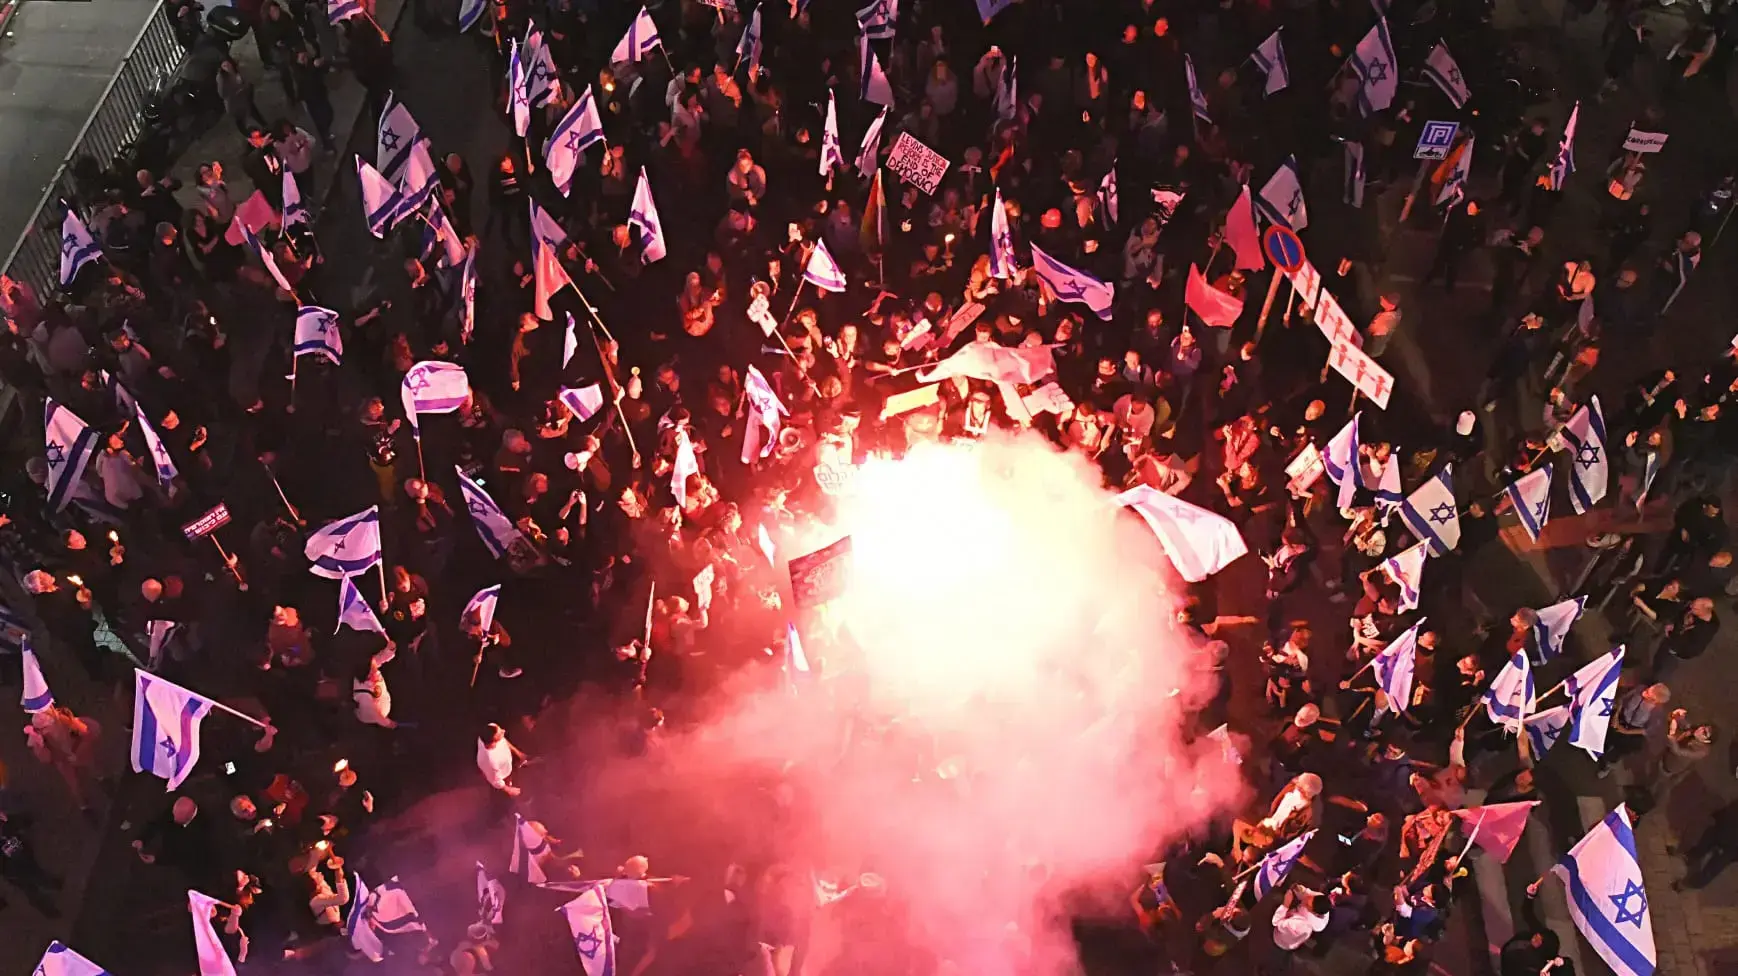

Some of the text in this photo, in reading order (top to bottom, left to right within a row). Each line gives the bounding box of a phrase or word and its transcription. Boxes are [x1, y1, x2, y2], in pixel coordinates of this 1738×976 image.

[888, 156, 937, 193] DEMOCRACY
[901, 155, 934, 179] END OF
[922, 158, 929, 168] IS
[931, 162, 943, 177] THE
